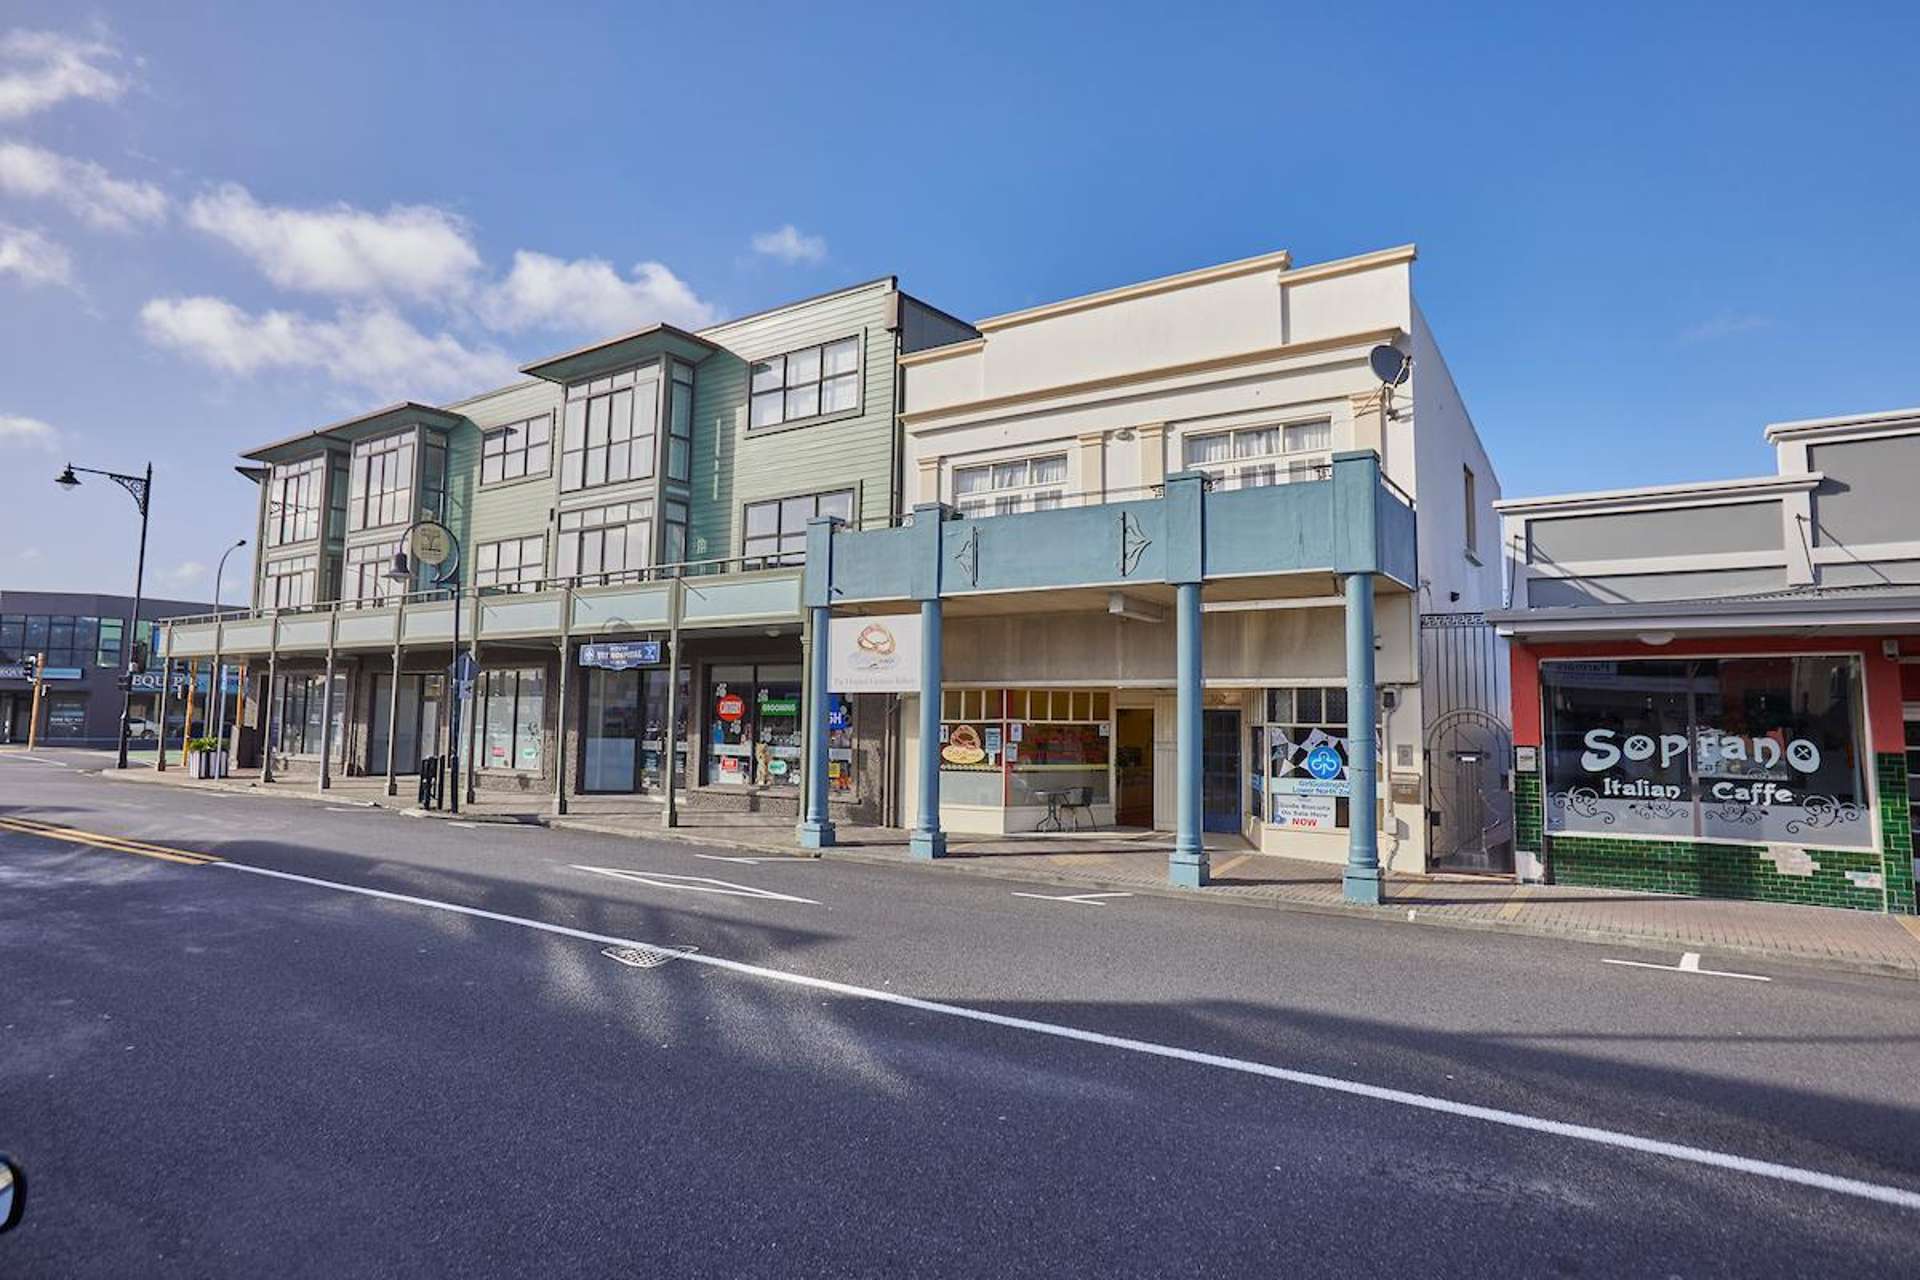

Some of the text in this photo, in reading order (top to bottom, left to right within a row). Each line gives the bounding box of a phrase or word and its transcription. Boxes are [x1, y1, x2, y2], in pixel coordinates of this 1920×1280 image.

[1580, 728, 1820, 774] Soprano
[1602, 777, 1793, 806] Italian Caffe
[1292, 818, 1317, 826] NOW
